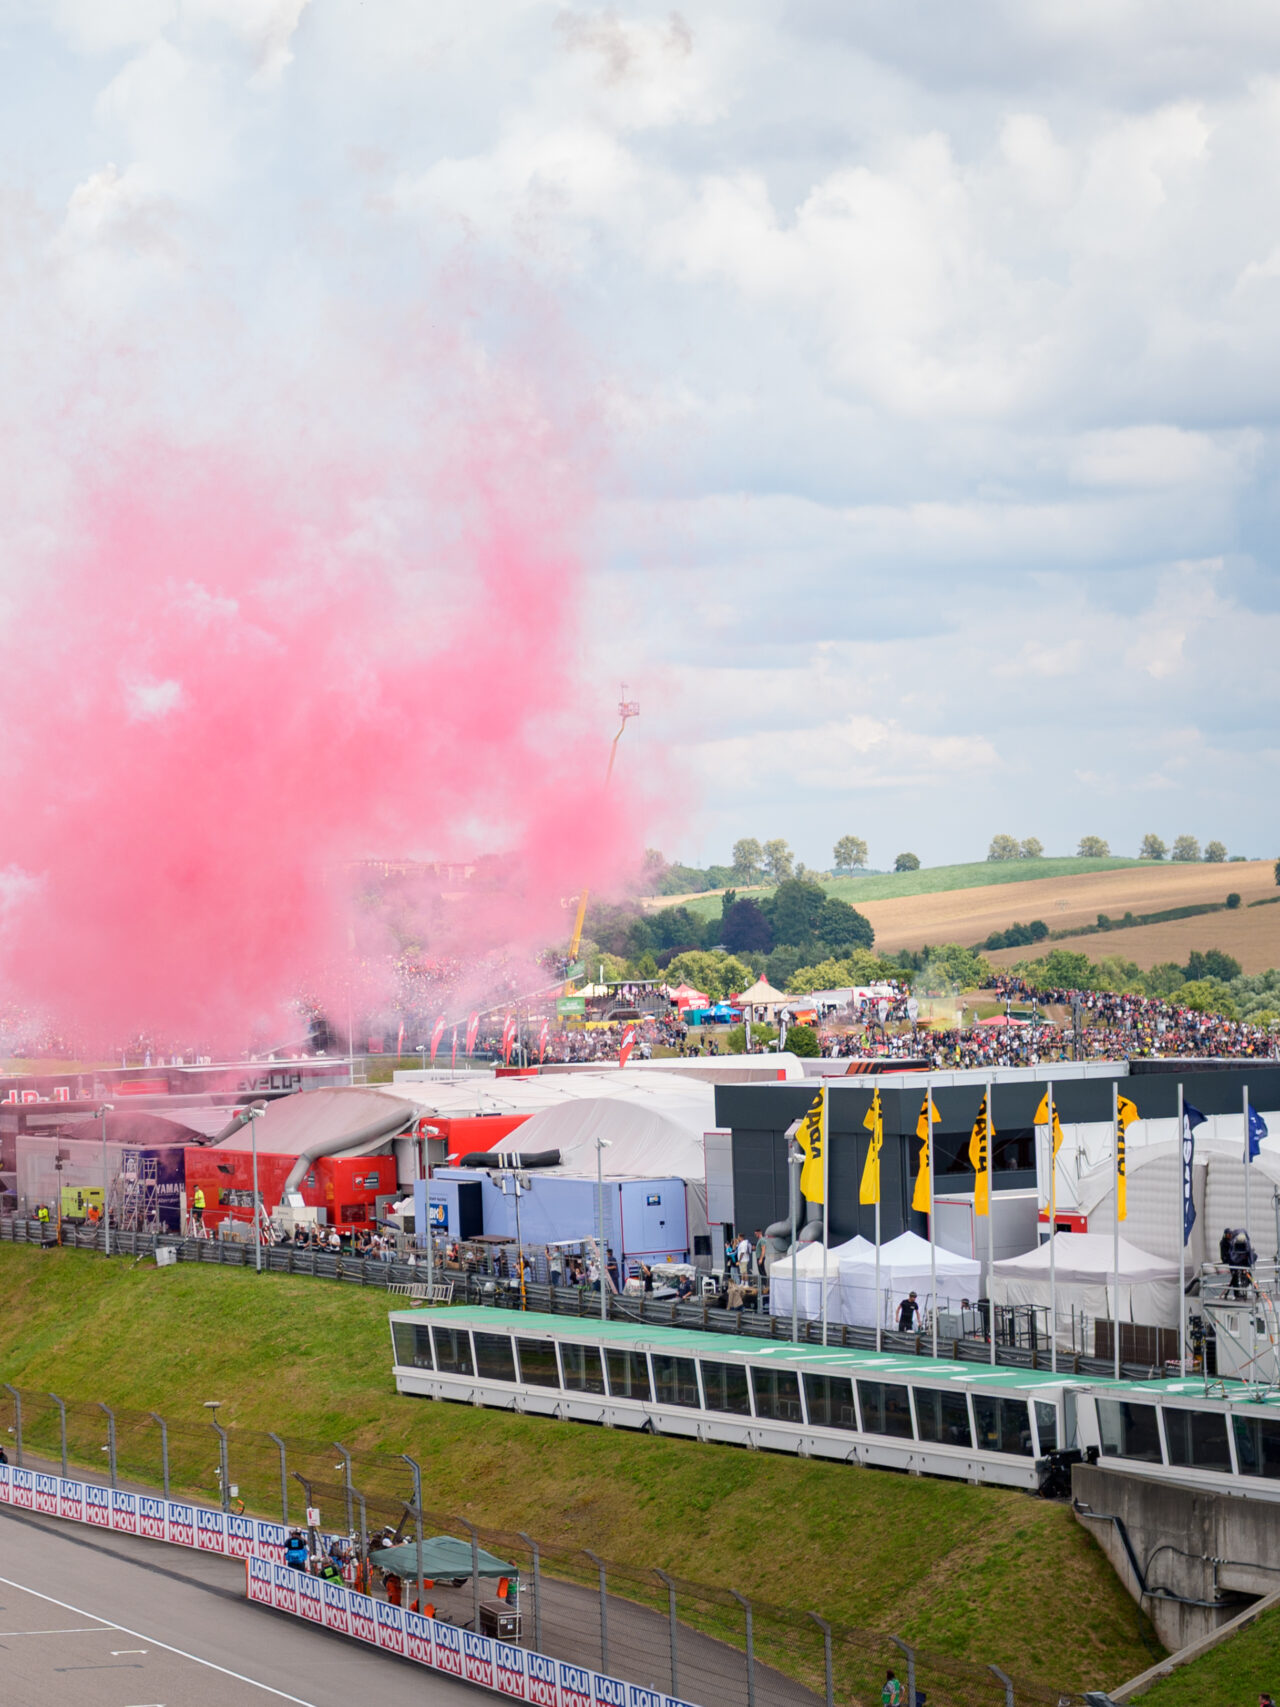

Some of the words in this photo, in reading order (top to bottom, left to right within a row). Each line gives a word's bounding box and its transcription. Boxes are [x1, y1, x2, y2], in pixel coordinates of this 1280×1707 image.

[21, 1087, 69, 1103] Bll
[157, 1183, 185, 1194] YAMAH
[14, 1470, 32, 1488] LIQUI
[37, 1476, 56, 1495] LIQUI
[61, 1482, 81, 1500] LIQUI
[14, 1487, 32, 1506] MOLY
[37, 1494, 56, 1513] MOLY
[87, 1488, 108, 1507] LIQUI
[114, 1493, 134, 1513] LIQUI
[61, 1500, 82, 1519] MOLY
[87, 1505, 108, 1525] MOLY
[114, 1511, 136, 1531] MOLY
[141, 1499, 163, 1519] LIQUI
[170, 1505, 191, 1525] LIQUI
[141, 1517, 164, 1538] MOLY
[198, 1511, 222, 1532] LIQUI
[229, 1518, 252, 1538] LIQUI
[170, 1524, 193, 1545] MOLY
[199, 1530, 223, 1551] MOLY
[259, 1524, 283, 1545] LIQUI
[229, 1537, 254, 1558] MOLY
[260, 1543, 286, 1565] MOLY
[251, 1558, 270, 1582] LIQUI
[275, 1566, 295, 1590] LIQUI
[251, 1579, 272, 1603] MOLY
[299, 1574, 319, 1599] LIQUI
[325, 1584, 345, 1609] LIQUI
[276, 1588, 297, 1612] MOLY
[300, 1597, 321, 1621] MOLY
[350, 1594, 372, 1619] LIQUI
[326, 1606, 347, 1631] MOLY
[352, 1616, 375, 1642] MOLY
[378, 1604, 401, 1630] LIQUI
[406, 1613, 429, 1640] LIQUI
[379, 1625, 404, 1652] MOLY
[435, 1624, 459, 1650] LIQUI
[464, 1634, 490, 1661] LIQUI
[408, 1636, 431, 1664] MOLY
[436, 1647, 461, 1674] MOLY
[496, 1644, 523, 1672] LIQUI
[466, 1658, 493, 1686] MOLY
[528, 1655, 554, 1683] LIQUI
[560, 1665, 589, 1695] LIQUI
[498, 1668, 524, 1697] MOLY
[530, 1679, 557, 1707] MOLY
[595, 1677, 624, 1706] LIQUI
